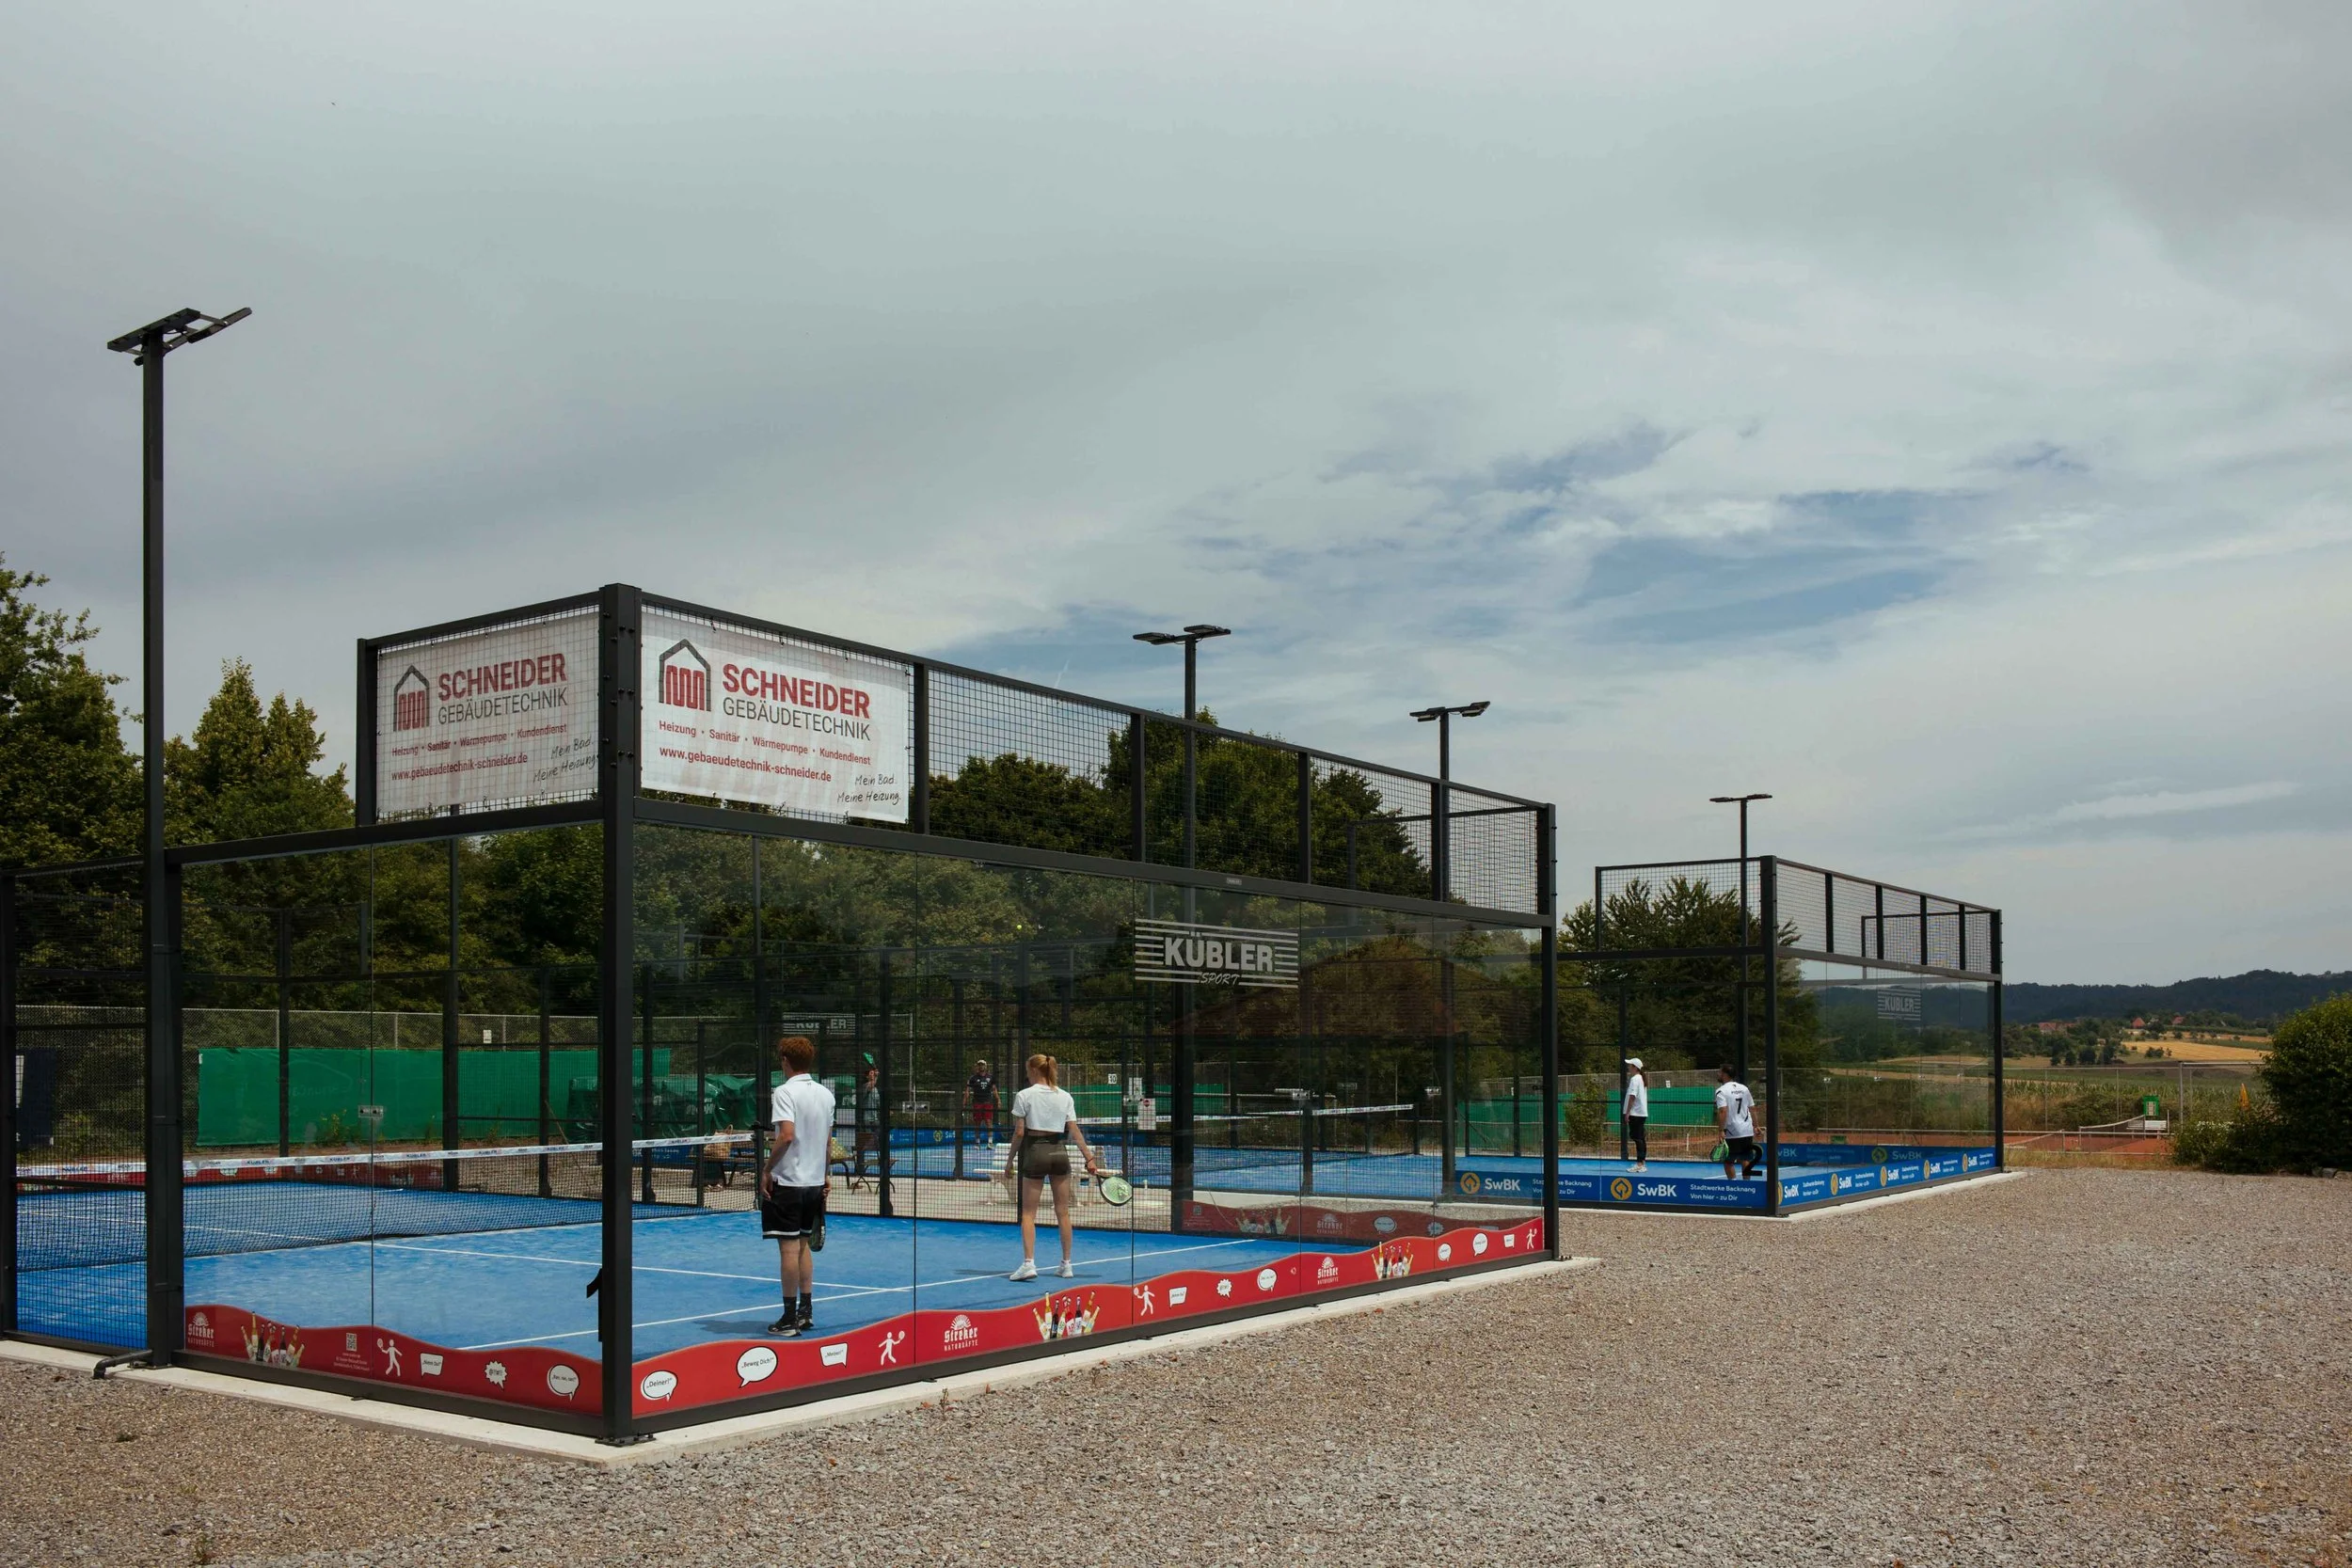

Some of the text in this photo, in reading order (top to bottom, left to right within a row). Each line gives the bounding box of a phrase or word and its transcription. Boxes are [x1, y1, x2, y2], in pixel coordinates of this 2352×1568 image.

[437, 653, 568, 702] SCHNEIDER
[723, 663, 870, 719] SCHNEIDER
[437, 687, 568, 725] GEBÄUDETECHNIK
[723, 697, 871, 741] GEBÄUDETECHNIK
[391, 723, 567, 757] Heizung Sanitär Wärmepumpe Kundendienst
[659, 721, 871, 766] Heizung Sanitär Wärmepumpe Kundendienst
[391, 752, 528, 781] www.gebaeudetechnik-schneider.de
[659, 747, 832, 783] www.gebaeudetechnik-schneider.de
[855, 774, 876, 786] Mein
[837, 791, 901, 806] Meine Heizung.
[1164, 931, 1273, 972] KÜBLER
[1199, 973, 1240, 985] SPORT
[1735, 1098, 1742, 1114] 7
[1742, 1145, 1763, 1176] 2
[1892, 1150, 1922, 1160] SwBK
[1485, 1178, 1520, 1191] SwBK
[1565, 1180, 1592, 1188] Backnang
[1637, 1183, 1677, 1197] SwBK
[1725, 1184, 1756, 1194] Backnang
[1784, 1184, 1799, 1198] SwBK
[1839, 1176, 1851, 1190] SwBK
[944, 1327, 977, 1342] Streker
